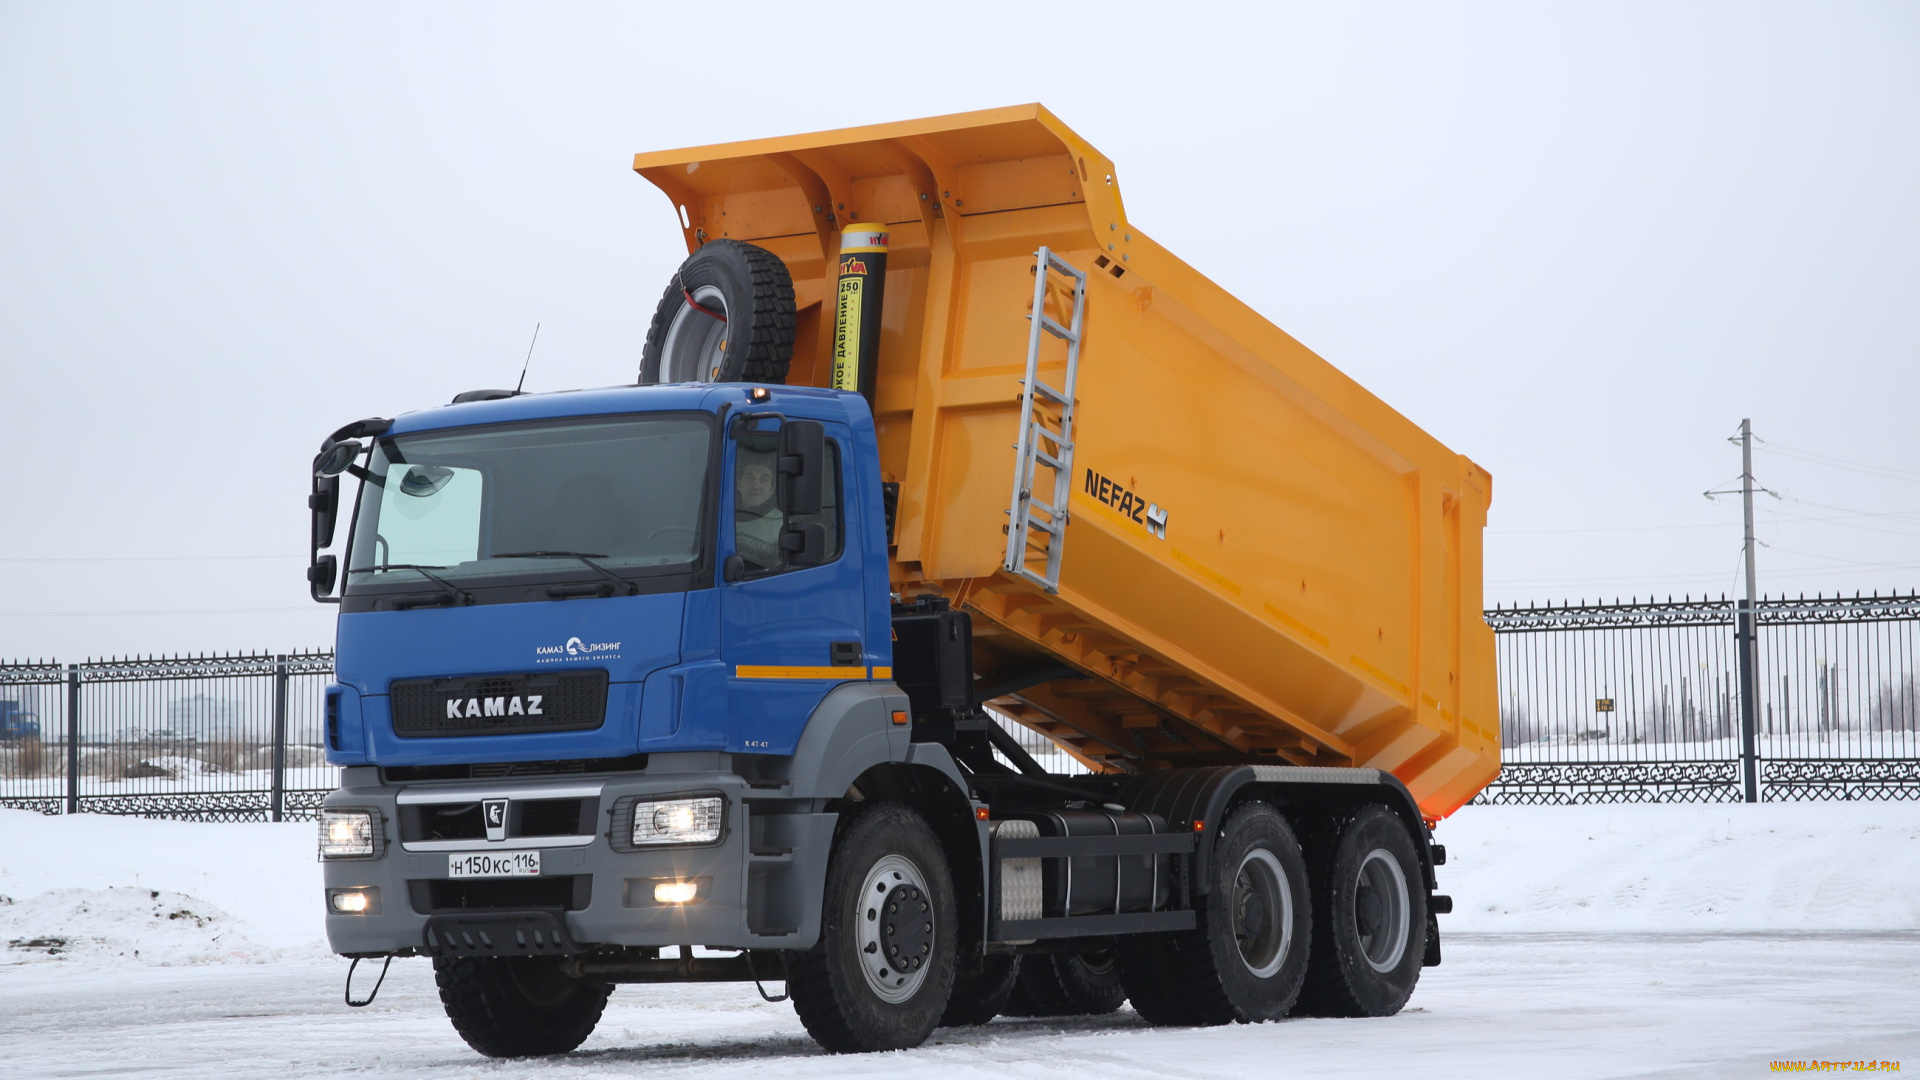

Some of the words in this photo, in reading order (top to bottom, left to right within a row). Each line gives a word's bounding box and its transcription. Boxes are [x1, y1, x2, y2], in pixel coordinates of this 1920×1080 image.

[840, 258, 867, 273] HYVA
[840, 282, 859, 292] 250
[837, 294, 848, 358] ДАВЛЕНИЕ
[1085, 468, 1145, 525] NEFAZ
[536, 645, 564, 655] КАМАЗ
[590, 642, 621, 652] ЛИЗИНГ
[446, 695, 543, 719] KAMAZ
[514, 853, 536, 868] 116
